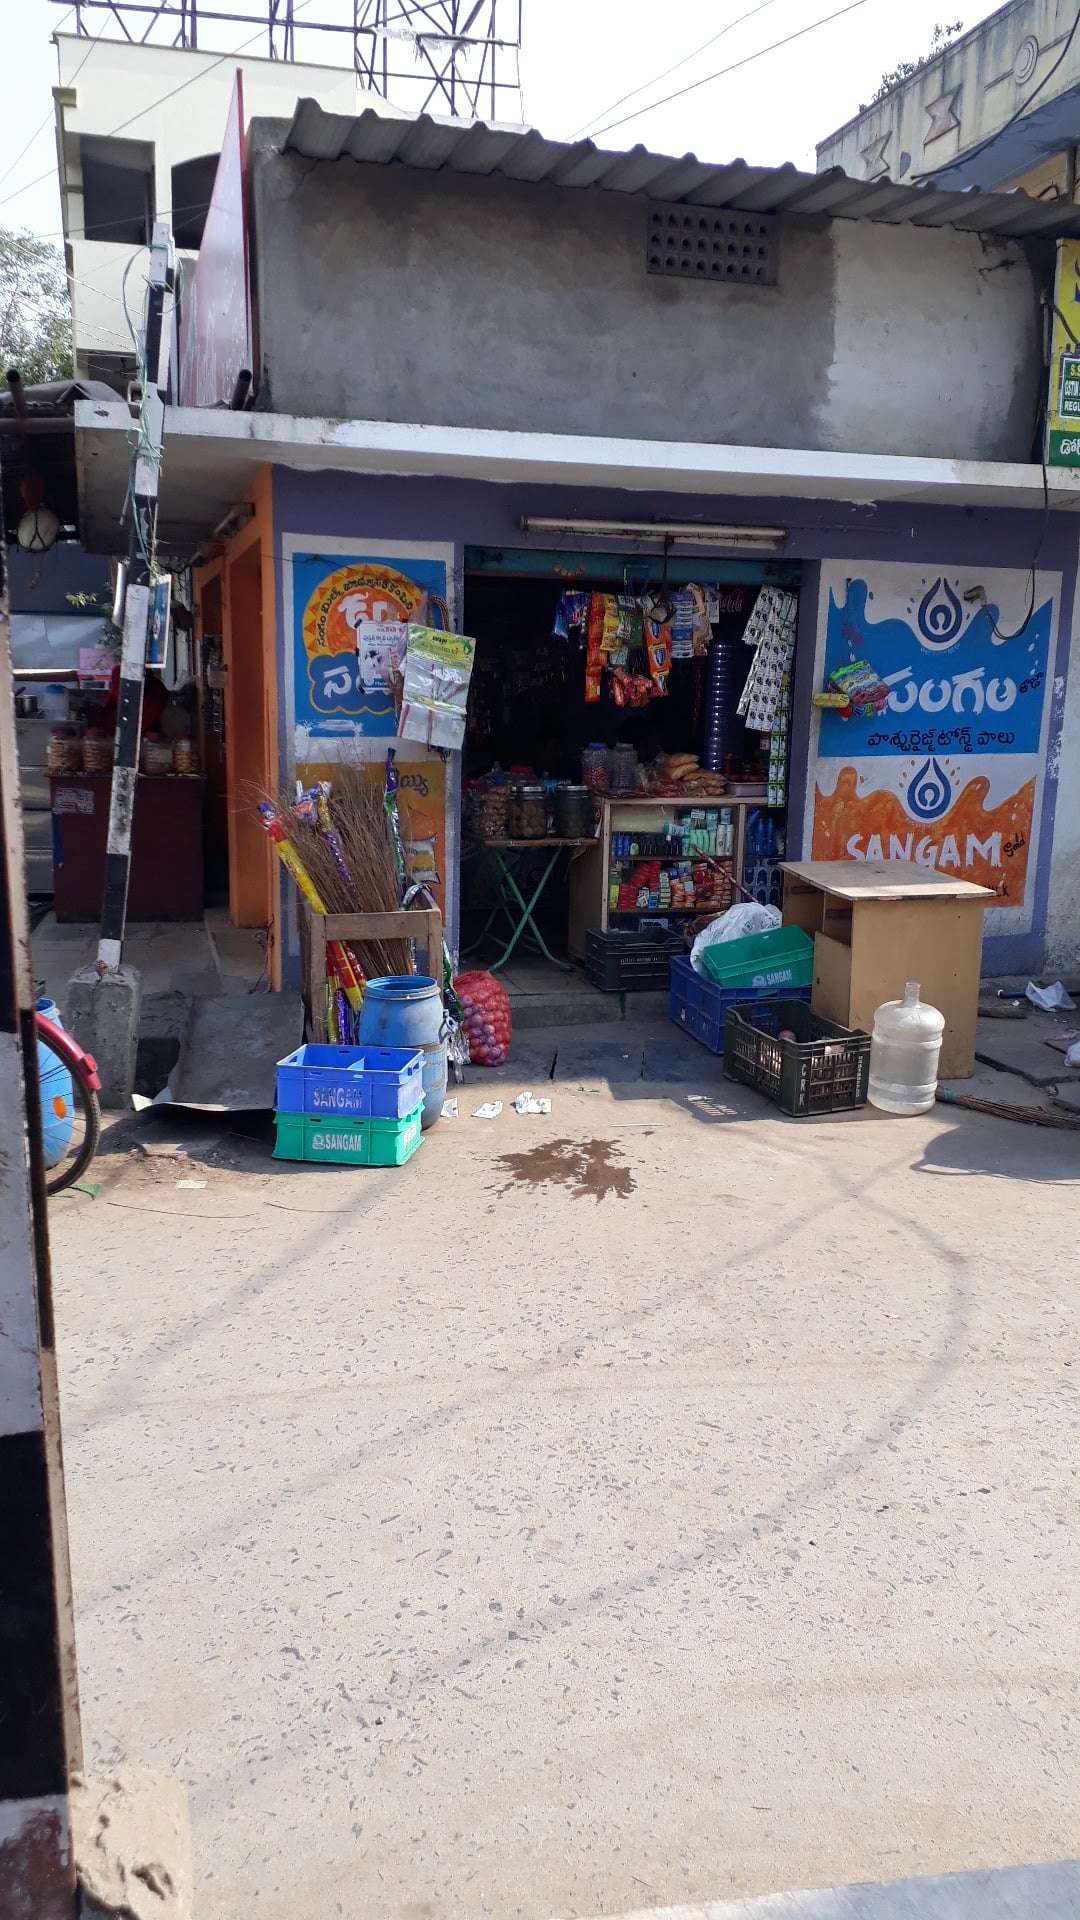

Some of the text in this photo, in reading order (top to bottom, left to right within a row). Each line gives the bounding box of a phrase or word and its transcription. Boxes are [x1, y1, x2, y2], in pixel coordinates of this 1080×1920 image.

[846, 831, 1003, 871] SANGAM
[766, 969, 793, 985] SANGAM
[325, 1133, 362, 1152] SANGAM
